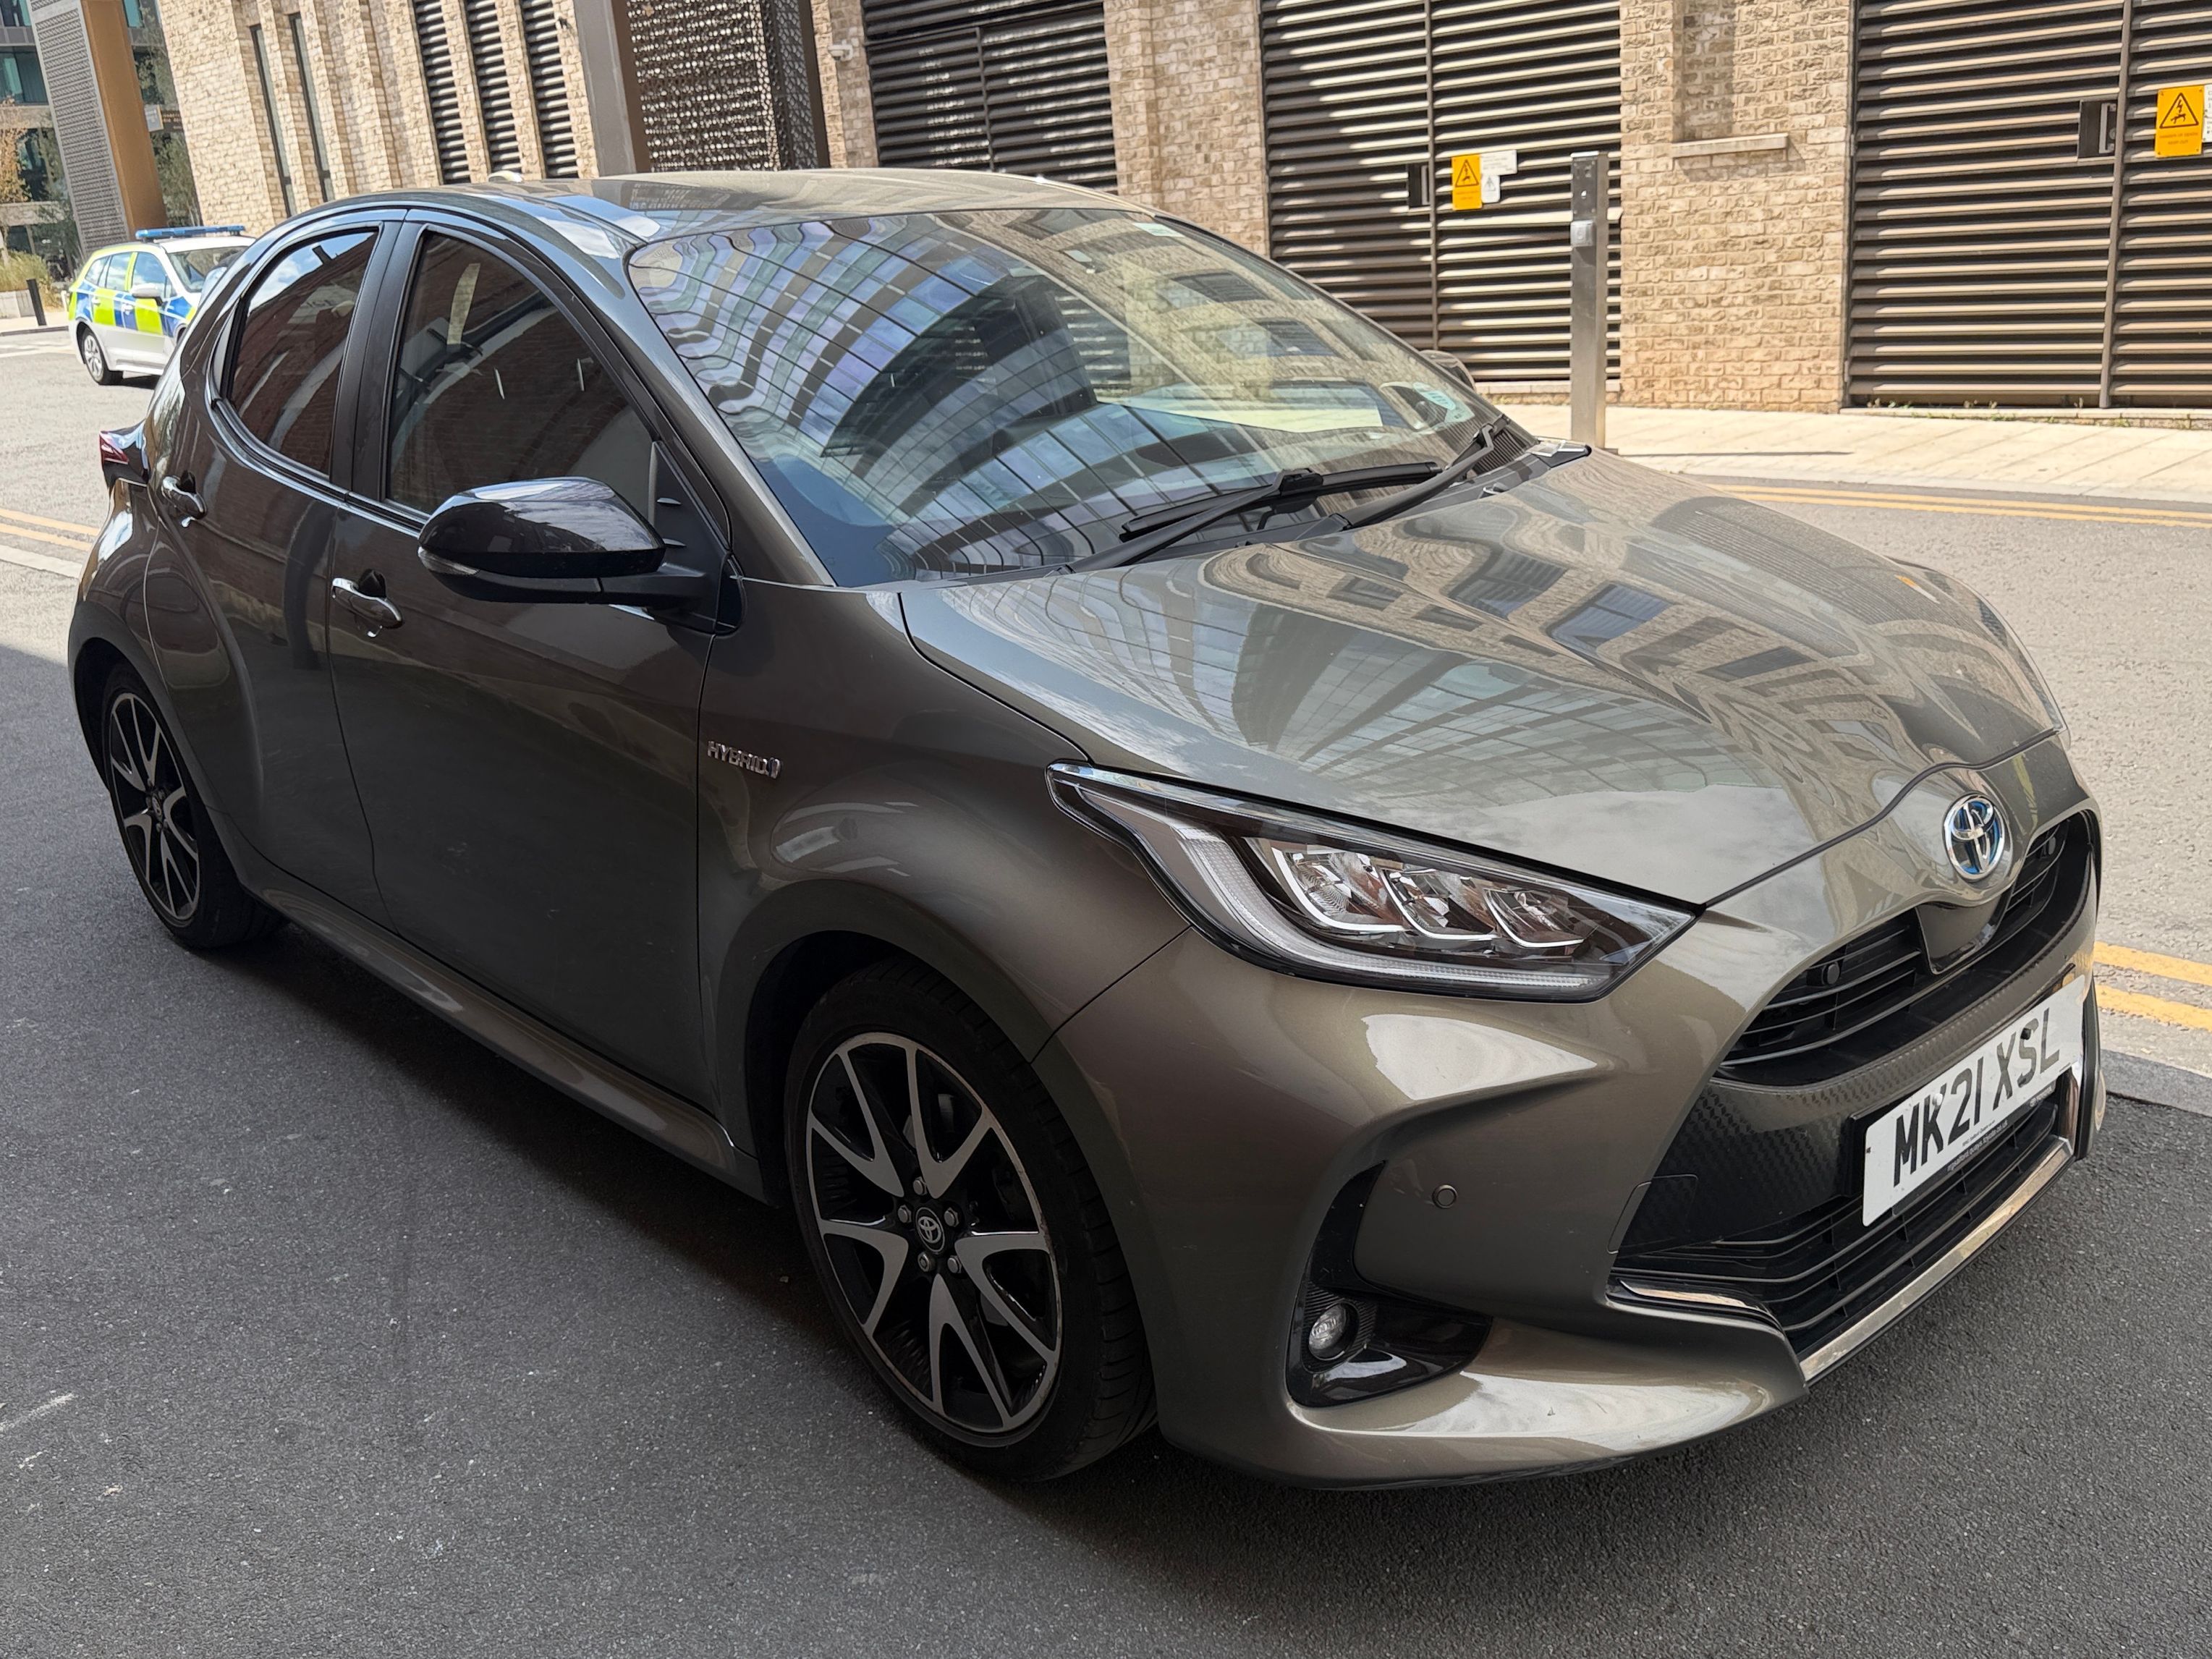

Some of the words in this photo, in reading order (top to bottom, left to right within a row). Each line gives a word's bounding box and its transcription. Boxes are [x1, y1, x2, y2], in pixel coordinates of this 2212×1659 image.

[707, 740, 770, 776] HYBRID
[1893, 1056, 1984, 1188] MK21
[1992, 1006, 2060, 1111] XSL
